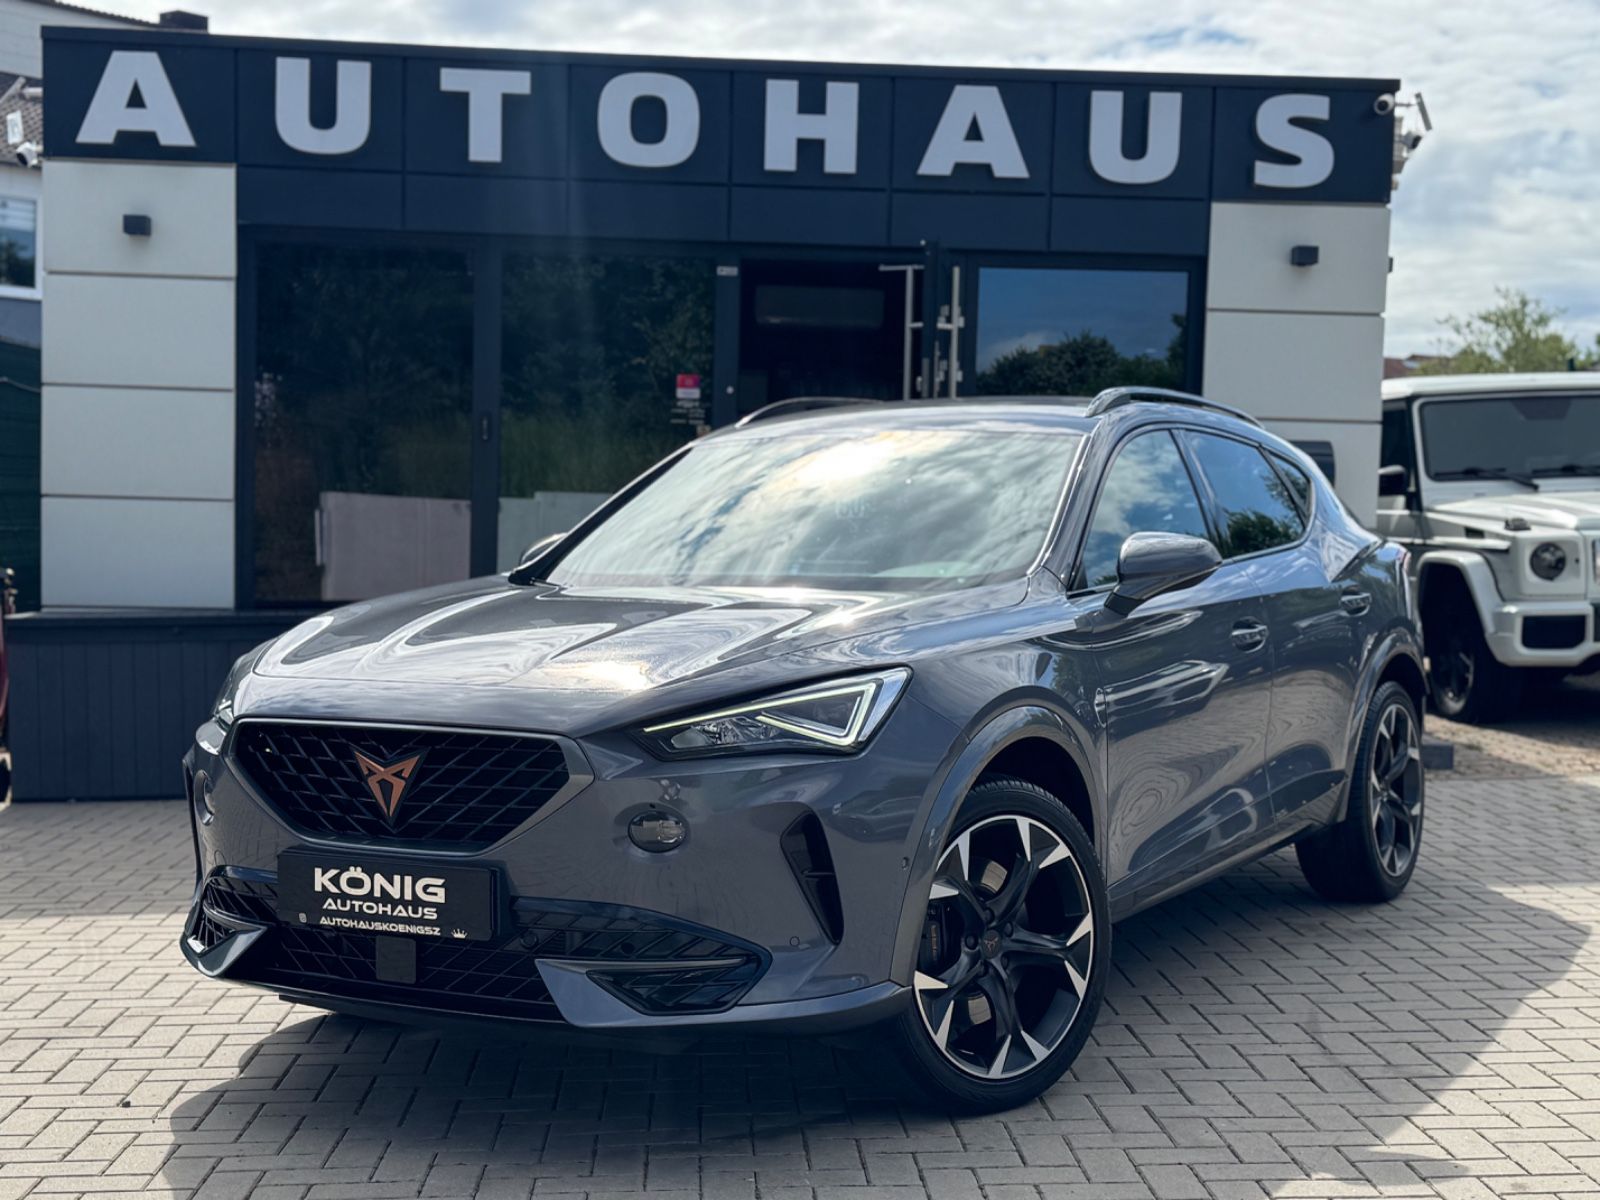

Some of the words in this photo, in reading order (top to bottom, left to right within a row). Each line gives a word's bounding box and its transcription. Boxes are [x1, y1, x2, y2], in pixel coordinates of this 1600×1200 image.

[75, 50, 1334, 188] AUTOHAUS
[314, 866, 446, 903] KÖNIG
[322, 898, 438, 920] AUTOHAUS
[319, 916, 441, 936] AUTOHAUSKOENIGSZ
